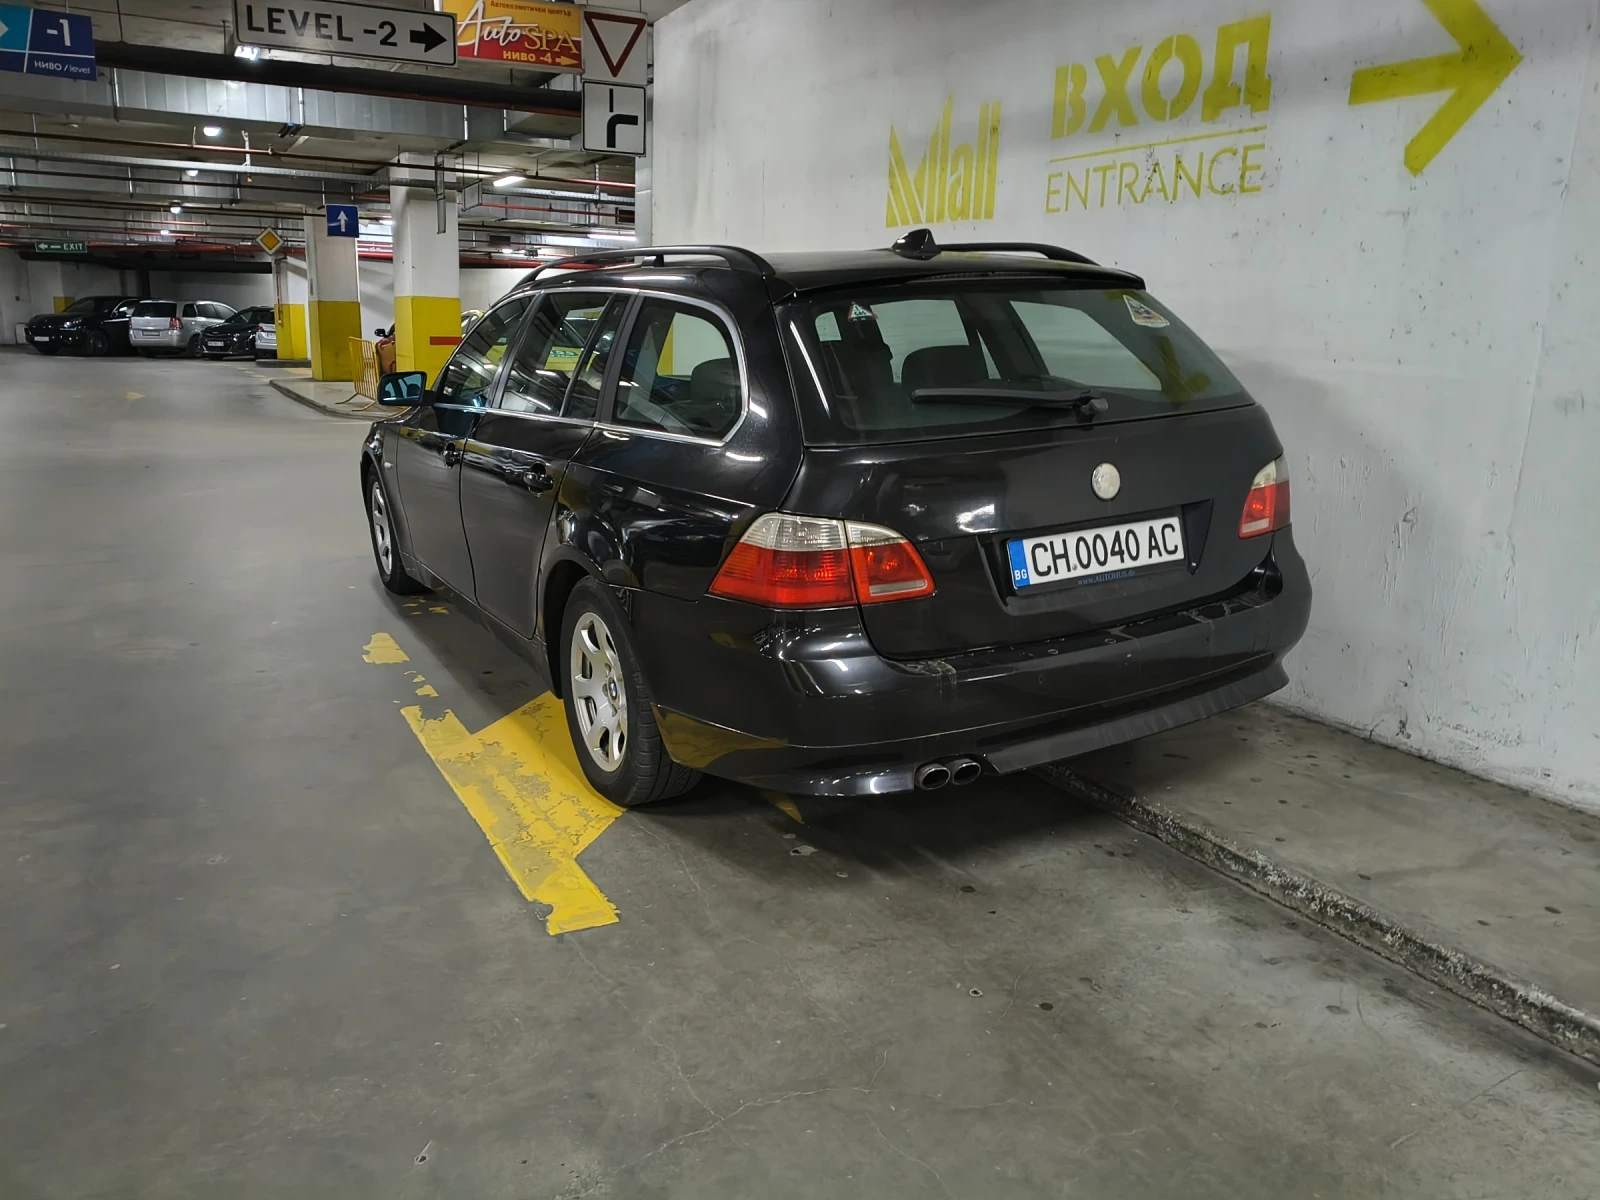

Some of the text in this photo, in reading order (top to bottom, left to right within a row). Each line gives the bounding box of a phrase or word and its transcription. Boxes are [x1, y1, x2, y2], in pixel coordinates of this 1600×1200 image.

[46, 18, 71, 47] -1
[246, 4, 398, 47] LEVEL -2
[457, 0, 580, 56] Auto SPA
[34, 60, 62, 71] НИВО
[69, 64, 91, 74] level
[503, 50, 552, 64] НИВО -4
[1051, 12, 1272, 140] ВХОД
[886, 90, 1003, 228] Mall
[1045, 143, 1267, 214] ENTRANCE
[63, 243, 83, 251] EXIT
[1014, 569, 1028, 581] BG
